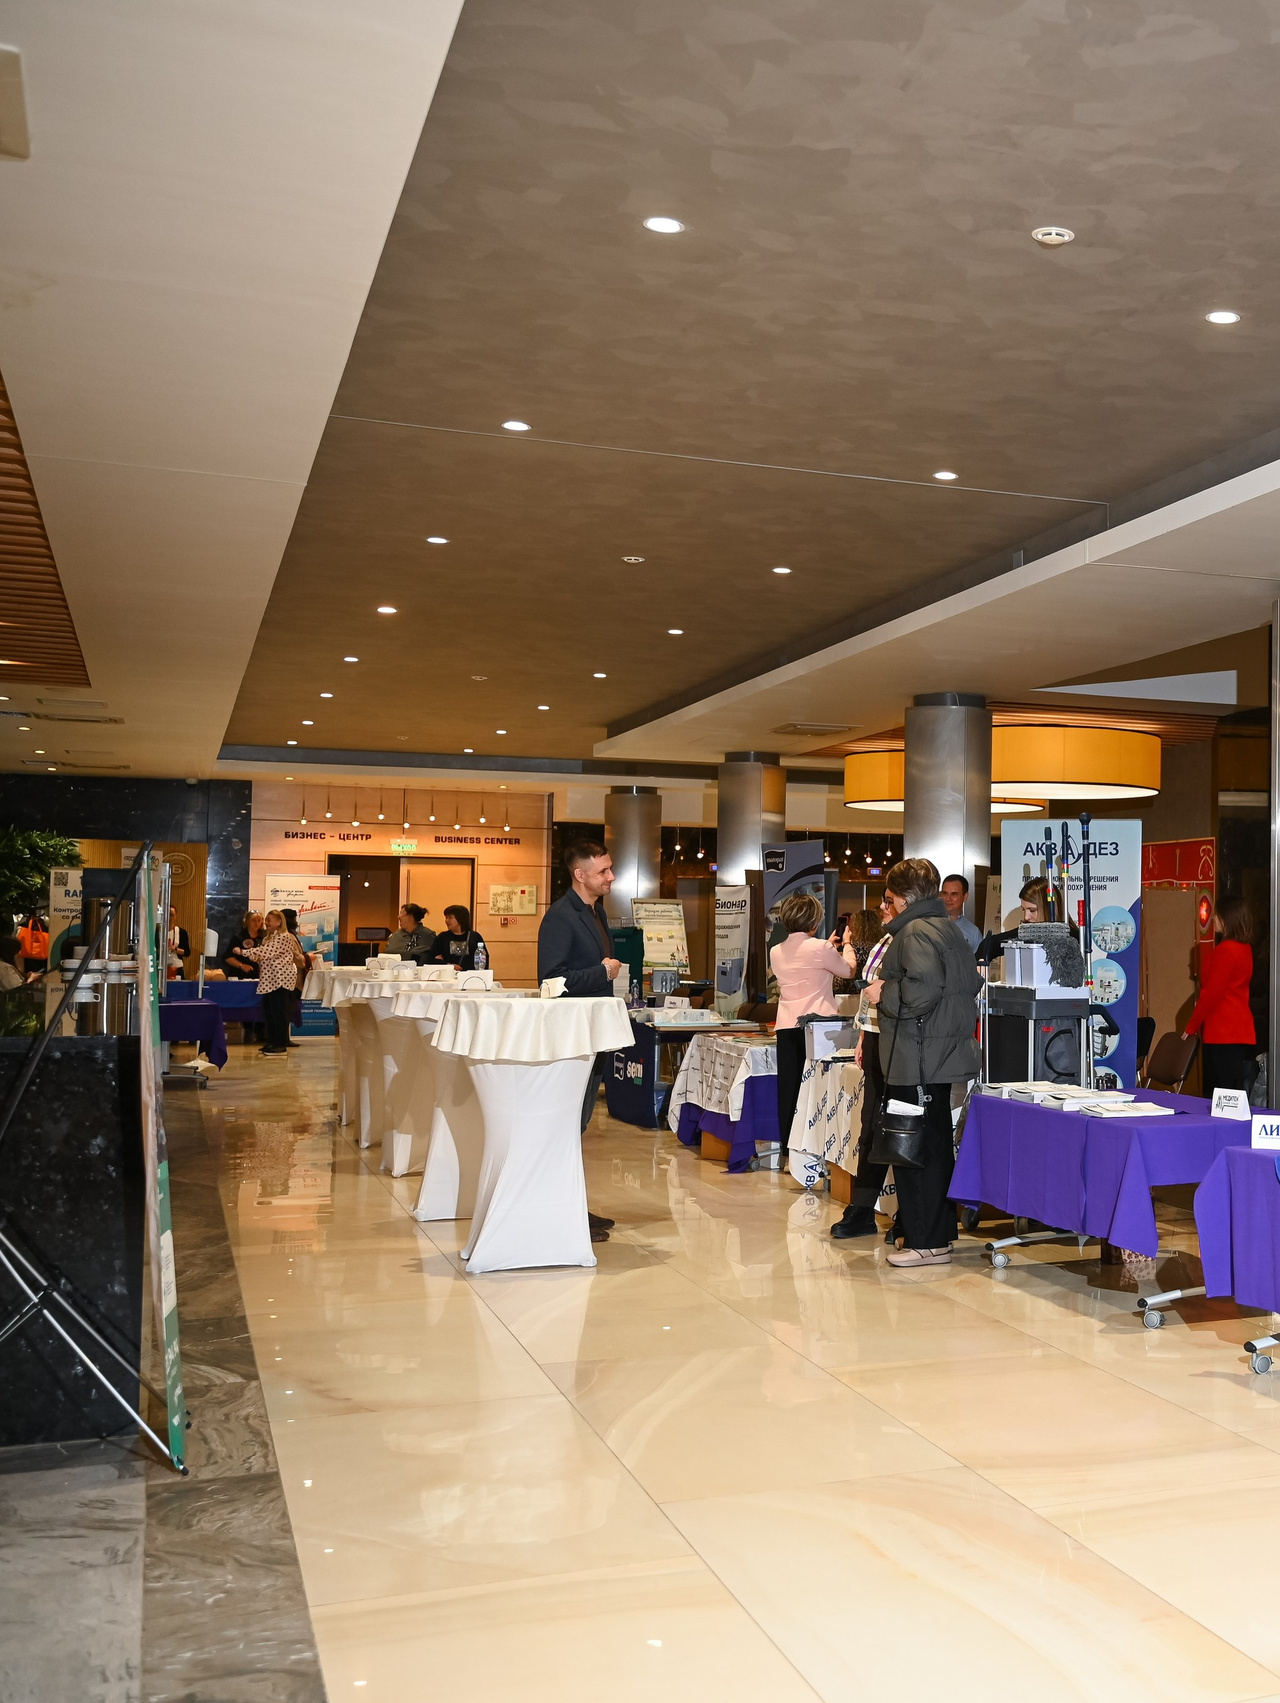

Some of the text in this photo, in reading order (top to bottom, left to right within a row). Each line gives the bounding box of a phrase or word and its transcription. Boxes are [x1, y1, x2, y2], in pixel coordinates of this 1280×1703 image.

[284, 831, 326, 840] БИЗНЕС
[339, 833, 372, 841] ЦЕНТР
[434, 836, 520, 845] BUSINESS CENTER
[715, 899, 747, 910] Бионар
